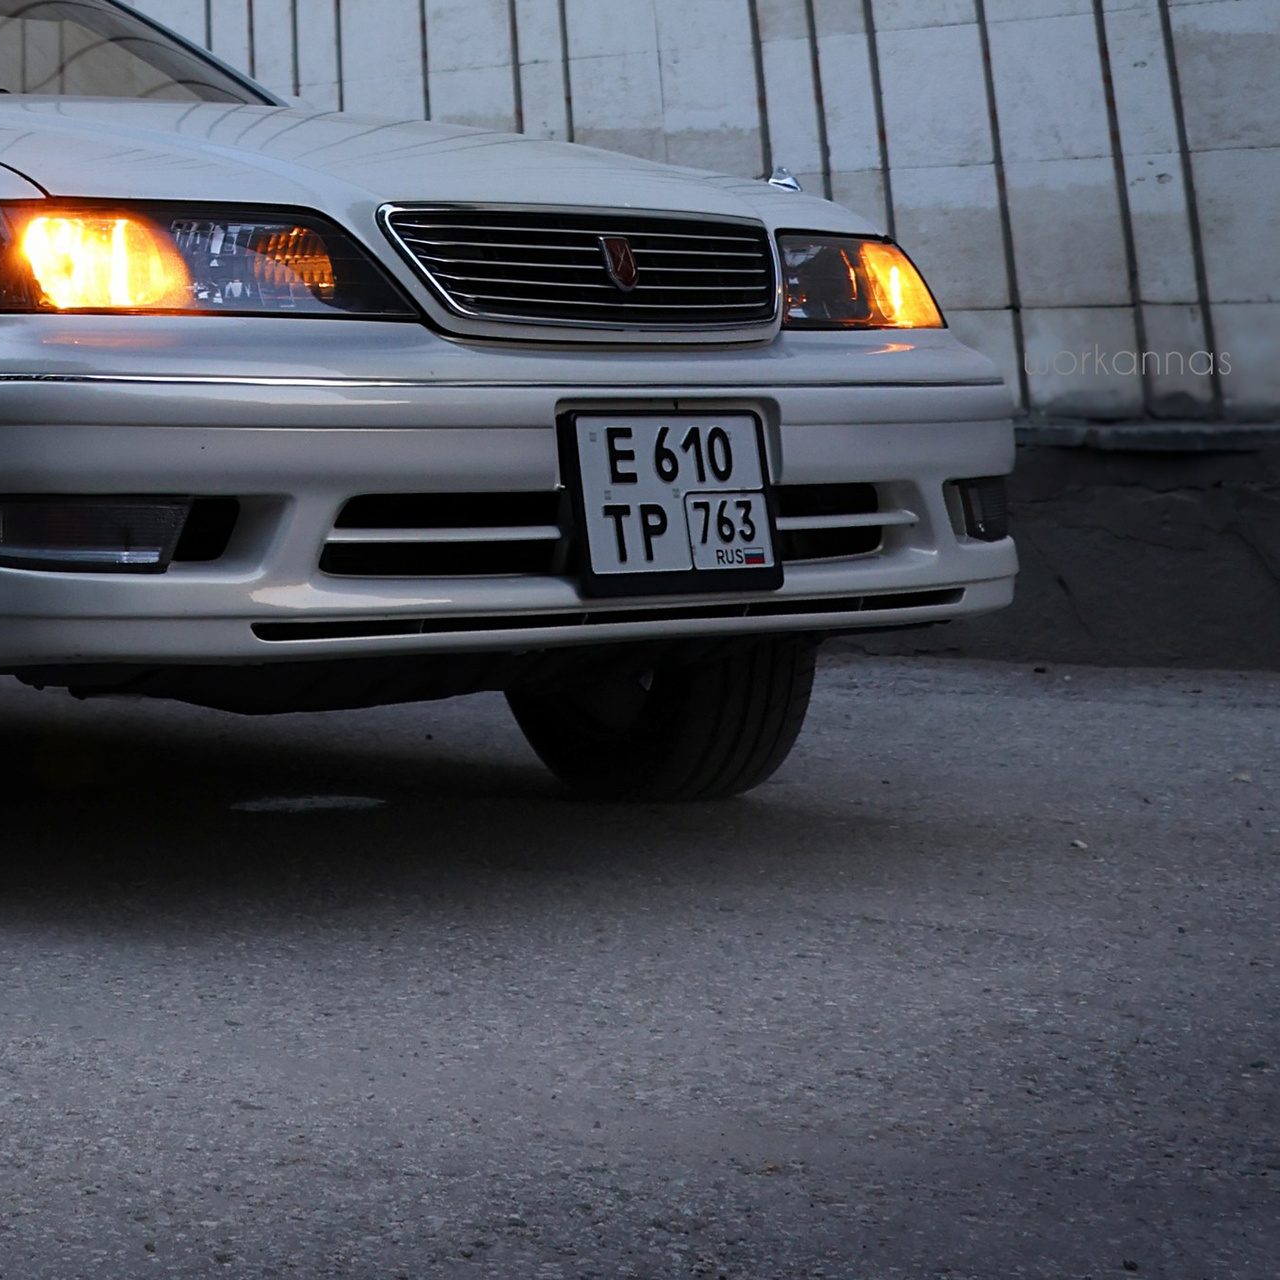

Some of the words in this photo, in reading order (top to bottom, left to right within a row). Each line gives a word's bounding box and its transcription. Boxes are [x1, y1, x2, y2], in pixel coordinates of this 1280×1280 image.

[654, 426, 733, 482] 610
[692, 500, 756, 544] 763
[716, 549, 744, 564] RUS
